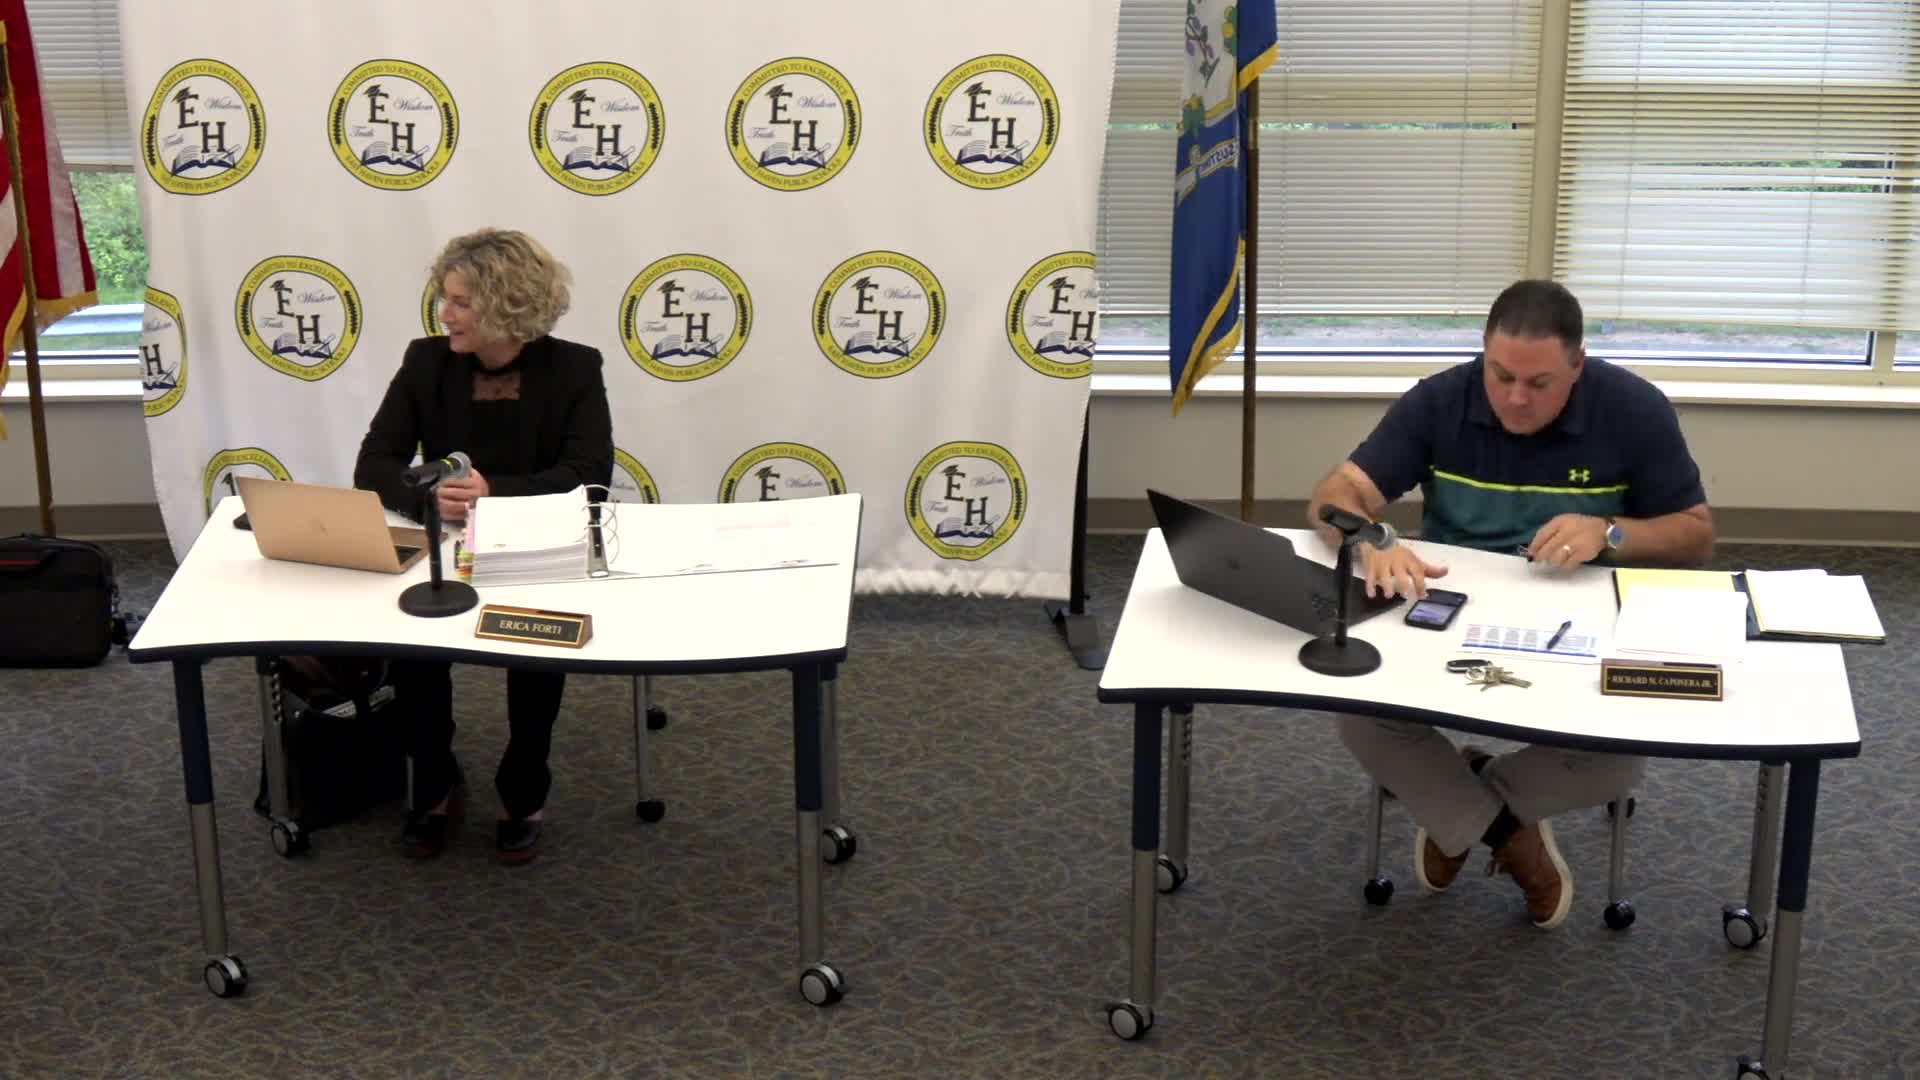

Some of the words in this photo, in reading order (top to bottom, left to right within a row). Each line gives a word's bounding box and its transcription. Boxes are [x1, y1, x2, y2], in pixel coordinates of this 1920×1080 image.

[743, 64, 789, 97] COMMITTED
[941, 62, 989, 94] COMMITTED
[394, 97, 433, 111] Wisdom
[996, 93, 1035, 106] Wisdom
[177, 93, 199, 129] E
[200, 121, 226, 153] H
[349, 125, 374, 137] Truth
[368, 91, 390, 124] E
[391, 120, 415, 154] H
[572, 96, 596, 129] E
[596, 124, 622, 156] H
[769, 91, 793, 124] E
[792, 120, 818, 151] H
[945, 125, 972, 137] Truth
[967, 89, 992, 122] E
[989, 117, 1016, 149] H
[829, 257, 875, 289] COMMITTED
[297, 290, 336, 304] Wisdom
[855, 283, 879, 315] E
[876, 310, 904, 341] H
[1049, 283, 1075, 315] E
[1069, 311, 1096, 341] H
[275, 287, 294, 318] E
[296, 314, 321, 344] H
[661, 287, 685, 318] E
[684, 312, 711, 343] H
[141, 343, 163, 377] H
[759, 472, 780, 502] E
[944, 471, 966, 502] E
[964, 496, 988, 526] H
[499, 620, 529, 632] ERICA
[532, 622, 562, 635] FORTI
[1612, 674, 1648, 684] RICHARD
